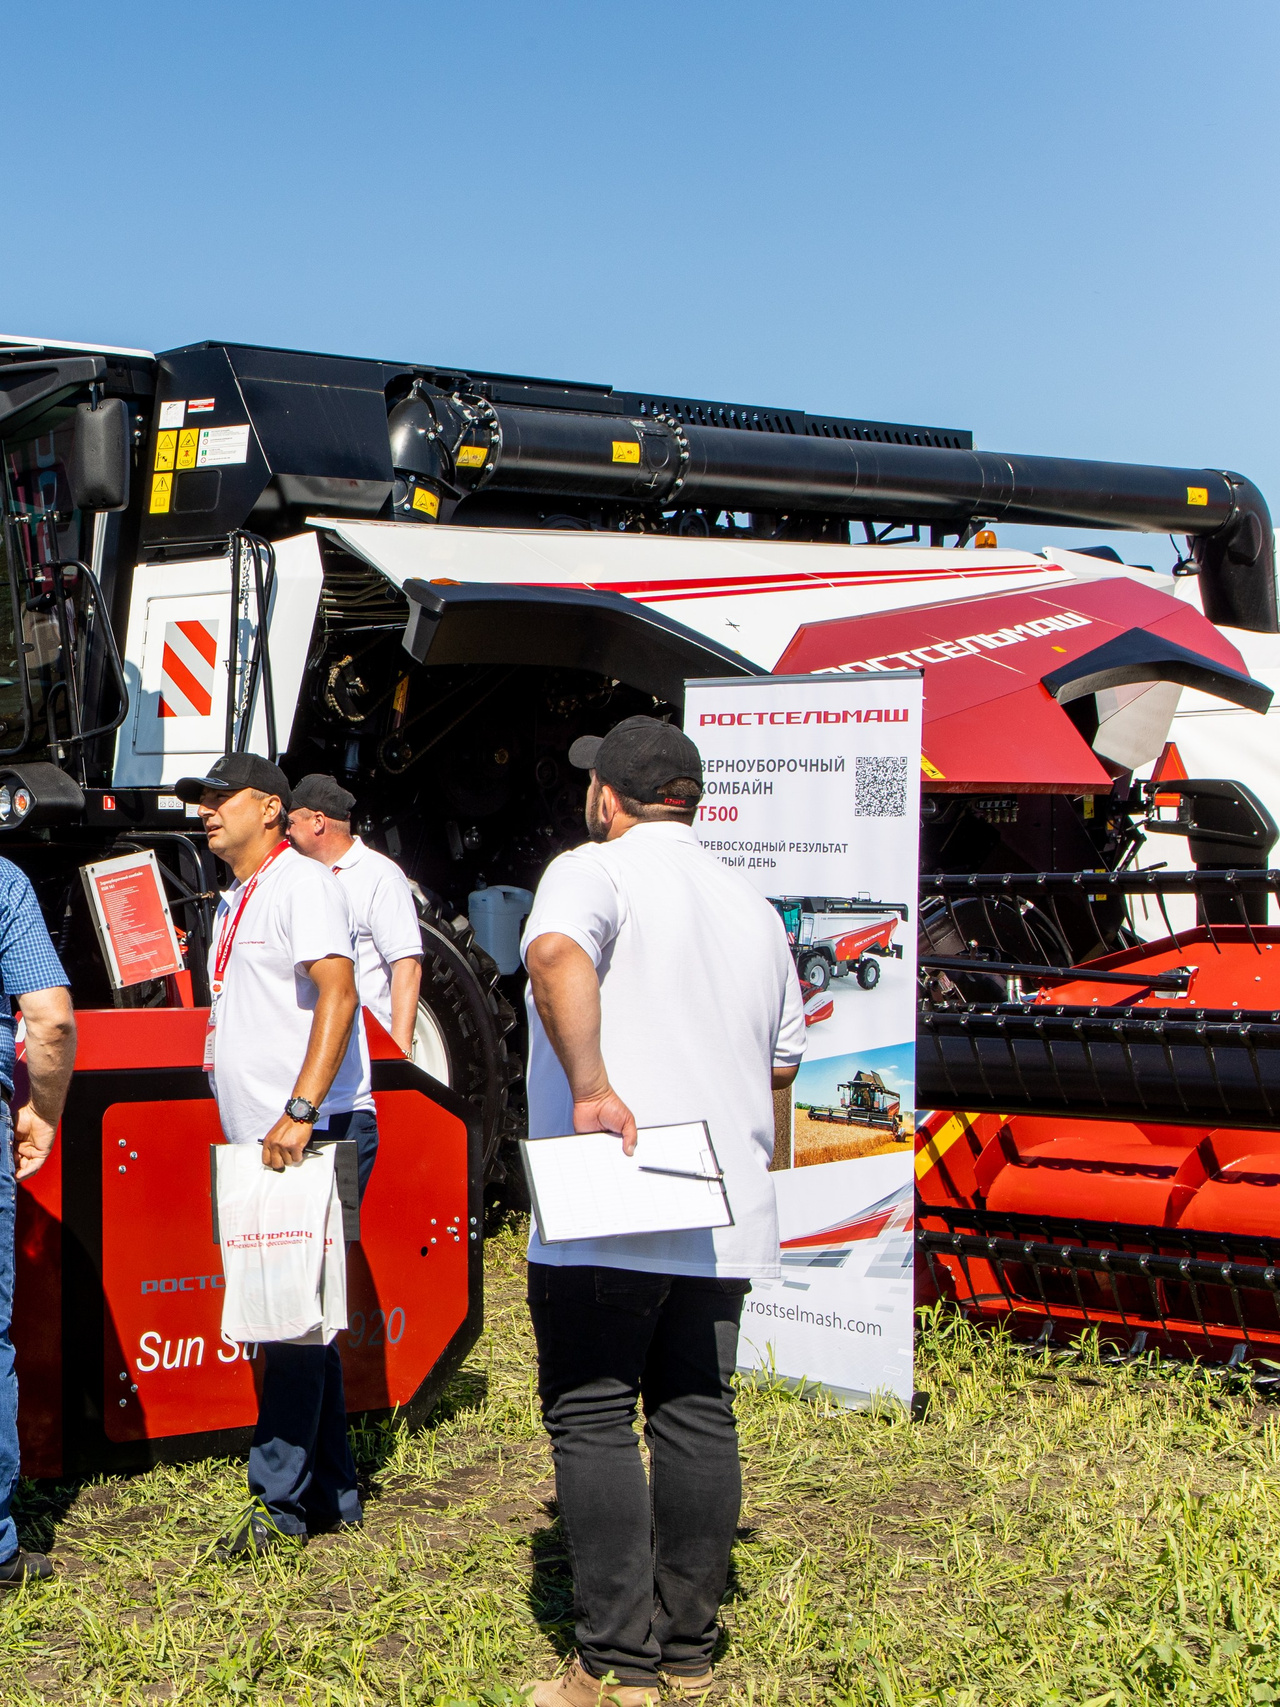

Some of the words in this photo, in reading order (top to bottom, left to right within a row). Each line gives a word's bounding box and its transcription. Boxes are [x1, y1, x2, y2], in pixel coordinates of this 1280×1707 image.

[699, 708, 910, 727] РОСТСЕЛЬМАШ
[789, 842, 848, 853] РЕЗУЛЬТАТ
[747, 857, 777, 869] ДЕНЬ
[141, 1274, 226, 1294] РОСТС
[136, 1330, 205, 1372] Sun
[347, 1306, 405, 1348] 920
